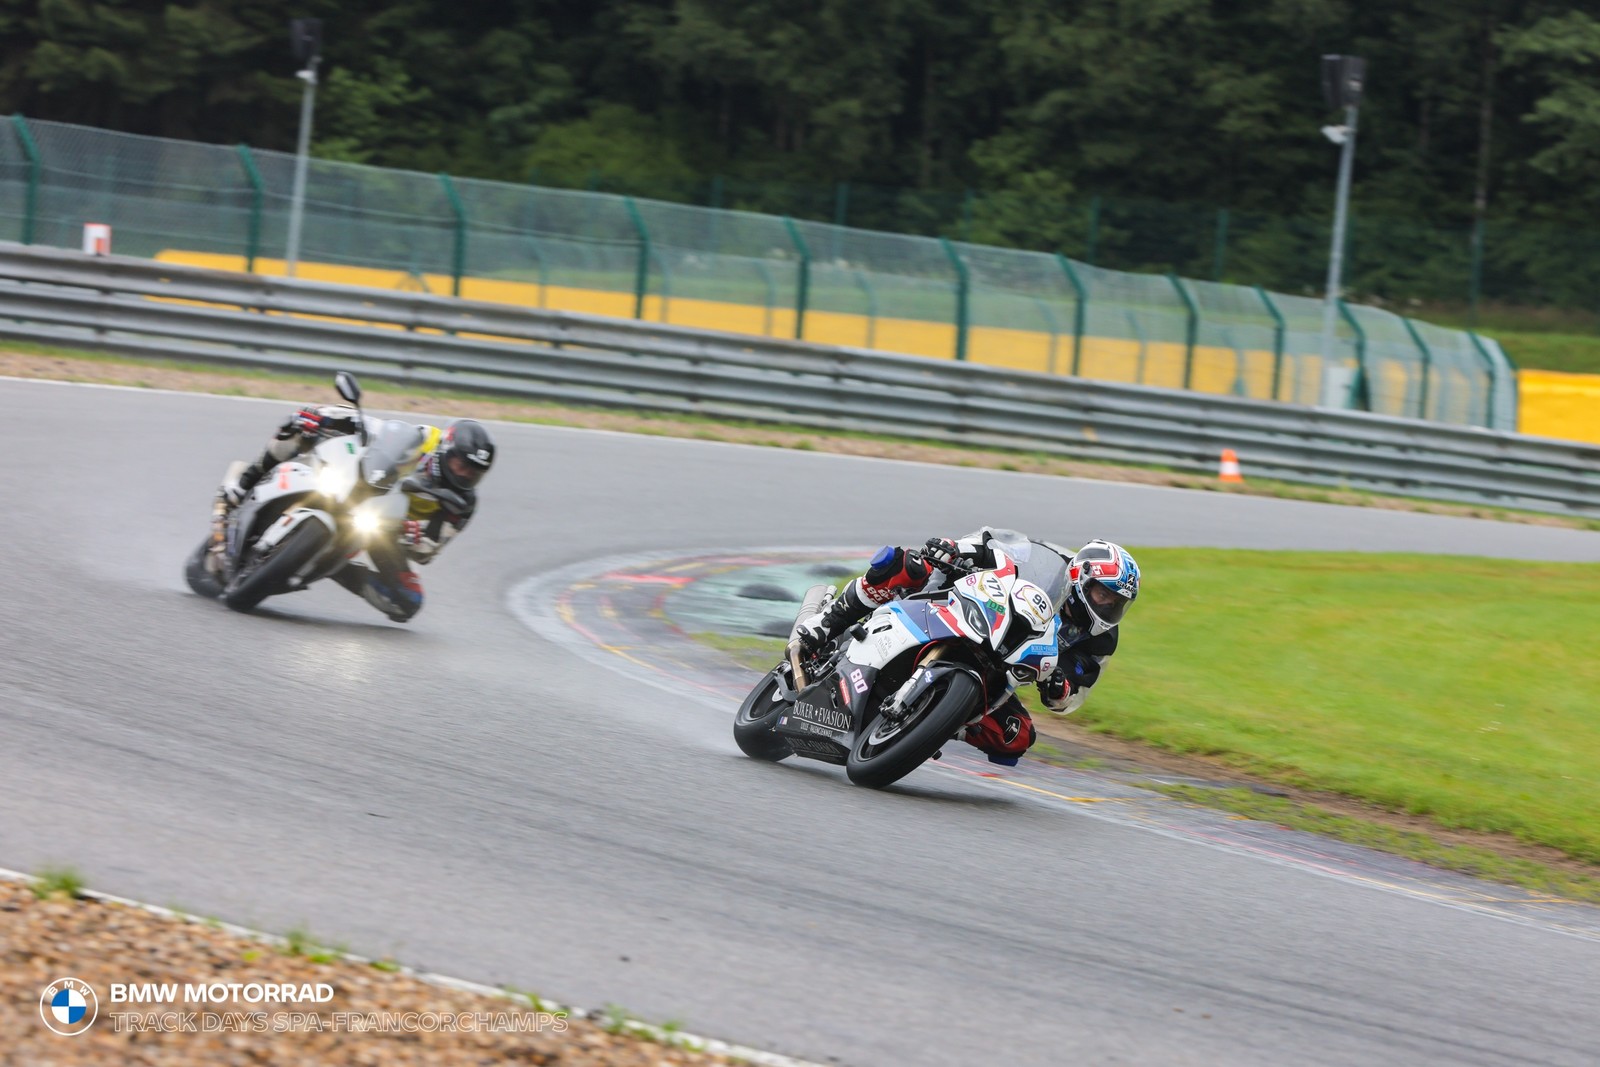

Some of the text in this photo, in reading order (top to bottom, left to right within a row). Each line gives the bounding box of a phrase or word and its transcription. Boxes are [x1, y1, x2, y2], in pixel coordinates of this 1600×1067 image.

[986, 577, 1005, 598] 171
[1032, 593, 1047, 613] 92
[850, 668, 868, 694] 80
[793, 700, 852, 730] BOXER EVASION
